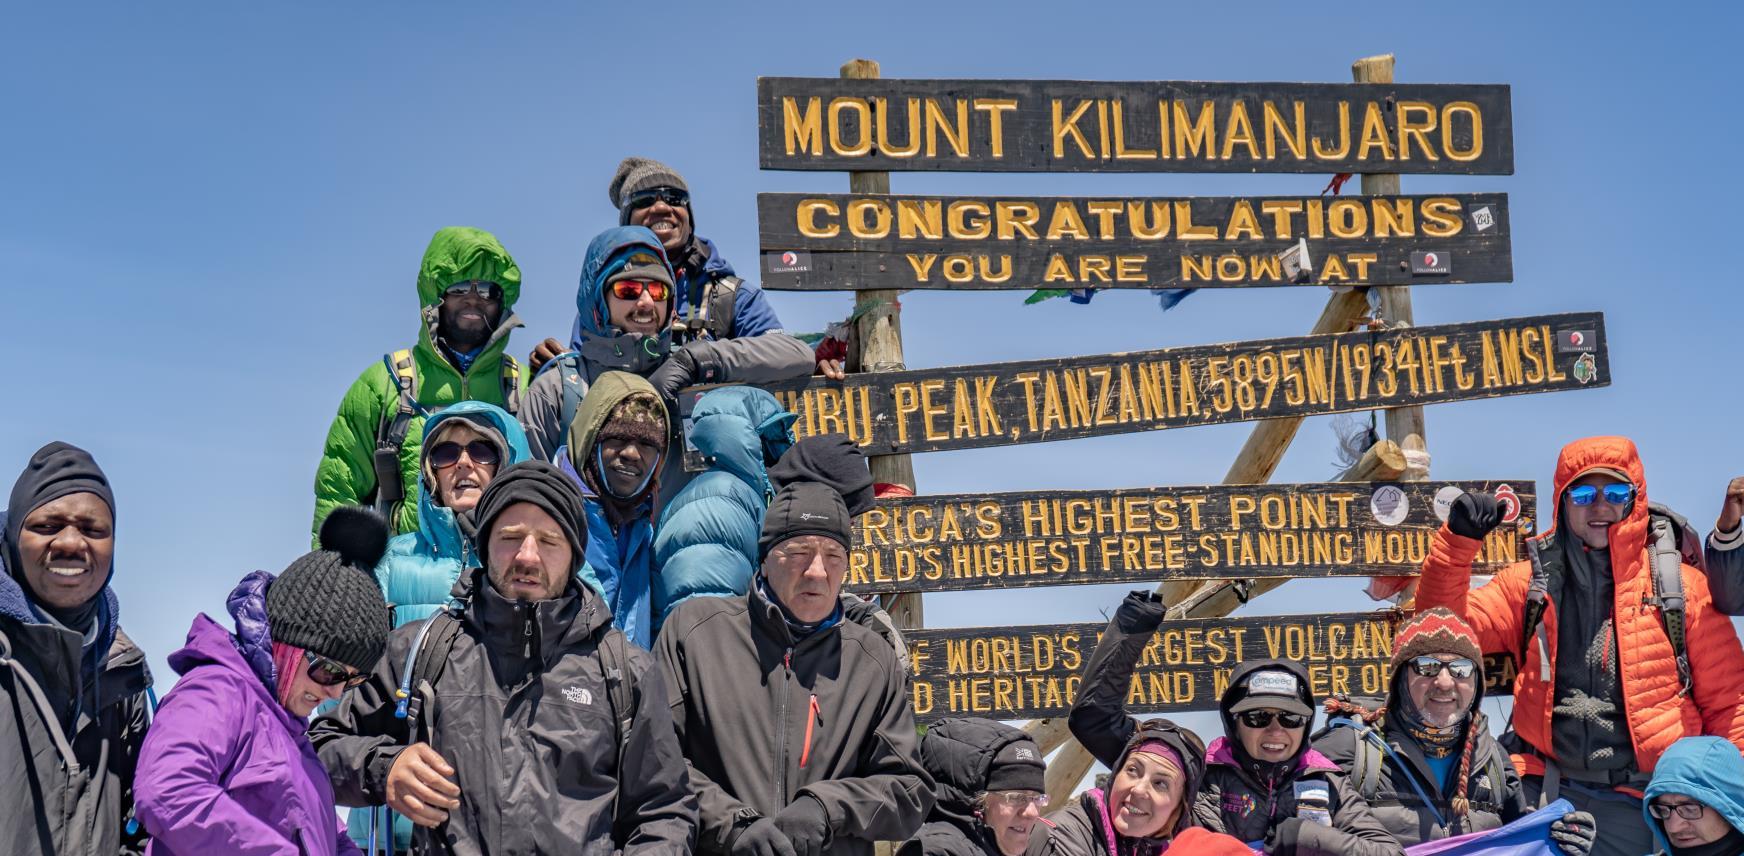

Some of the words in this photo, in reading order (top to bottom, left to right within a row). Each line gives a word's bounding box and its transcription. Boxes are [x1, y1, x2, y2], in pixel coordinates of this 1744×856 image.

[783, 96, 1018, 158] MOUNT
[1052, 99, 1484, 162] KILIMANJARO
[796, 198, 1464, 240] CONGRATULATIONS
[906, 254, 1012, 282] YOU
[1044, 254, 1148, 282] ARE
[1181, 254, 1282, 281] NOW
[1320, 253, 1378, 281] AT
[1481, 325, 1566, 389] AMSL
[863, 500, 1002, 546] RICA'S
[1023, 494, 1208, 537] HIGHEST
[1230, 492, 1355, 531] POINT
[842, 544, 943, 585] RLD'S
[952, 537, 1090, 579] HIGHEST
[1100, 531, 1354, 571] FREE-STANDING
[947, 632, 1082, 675] WORLD'S
[1263, 619, 1392, 661] VOLCAN
[561, 688, 582, 698] NORTH
[949, 673, 1081, 713] HERITA
[1127, 670, 1195, 705] AND
